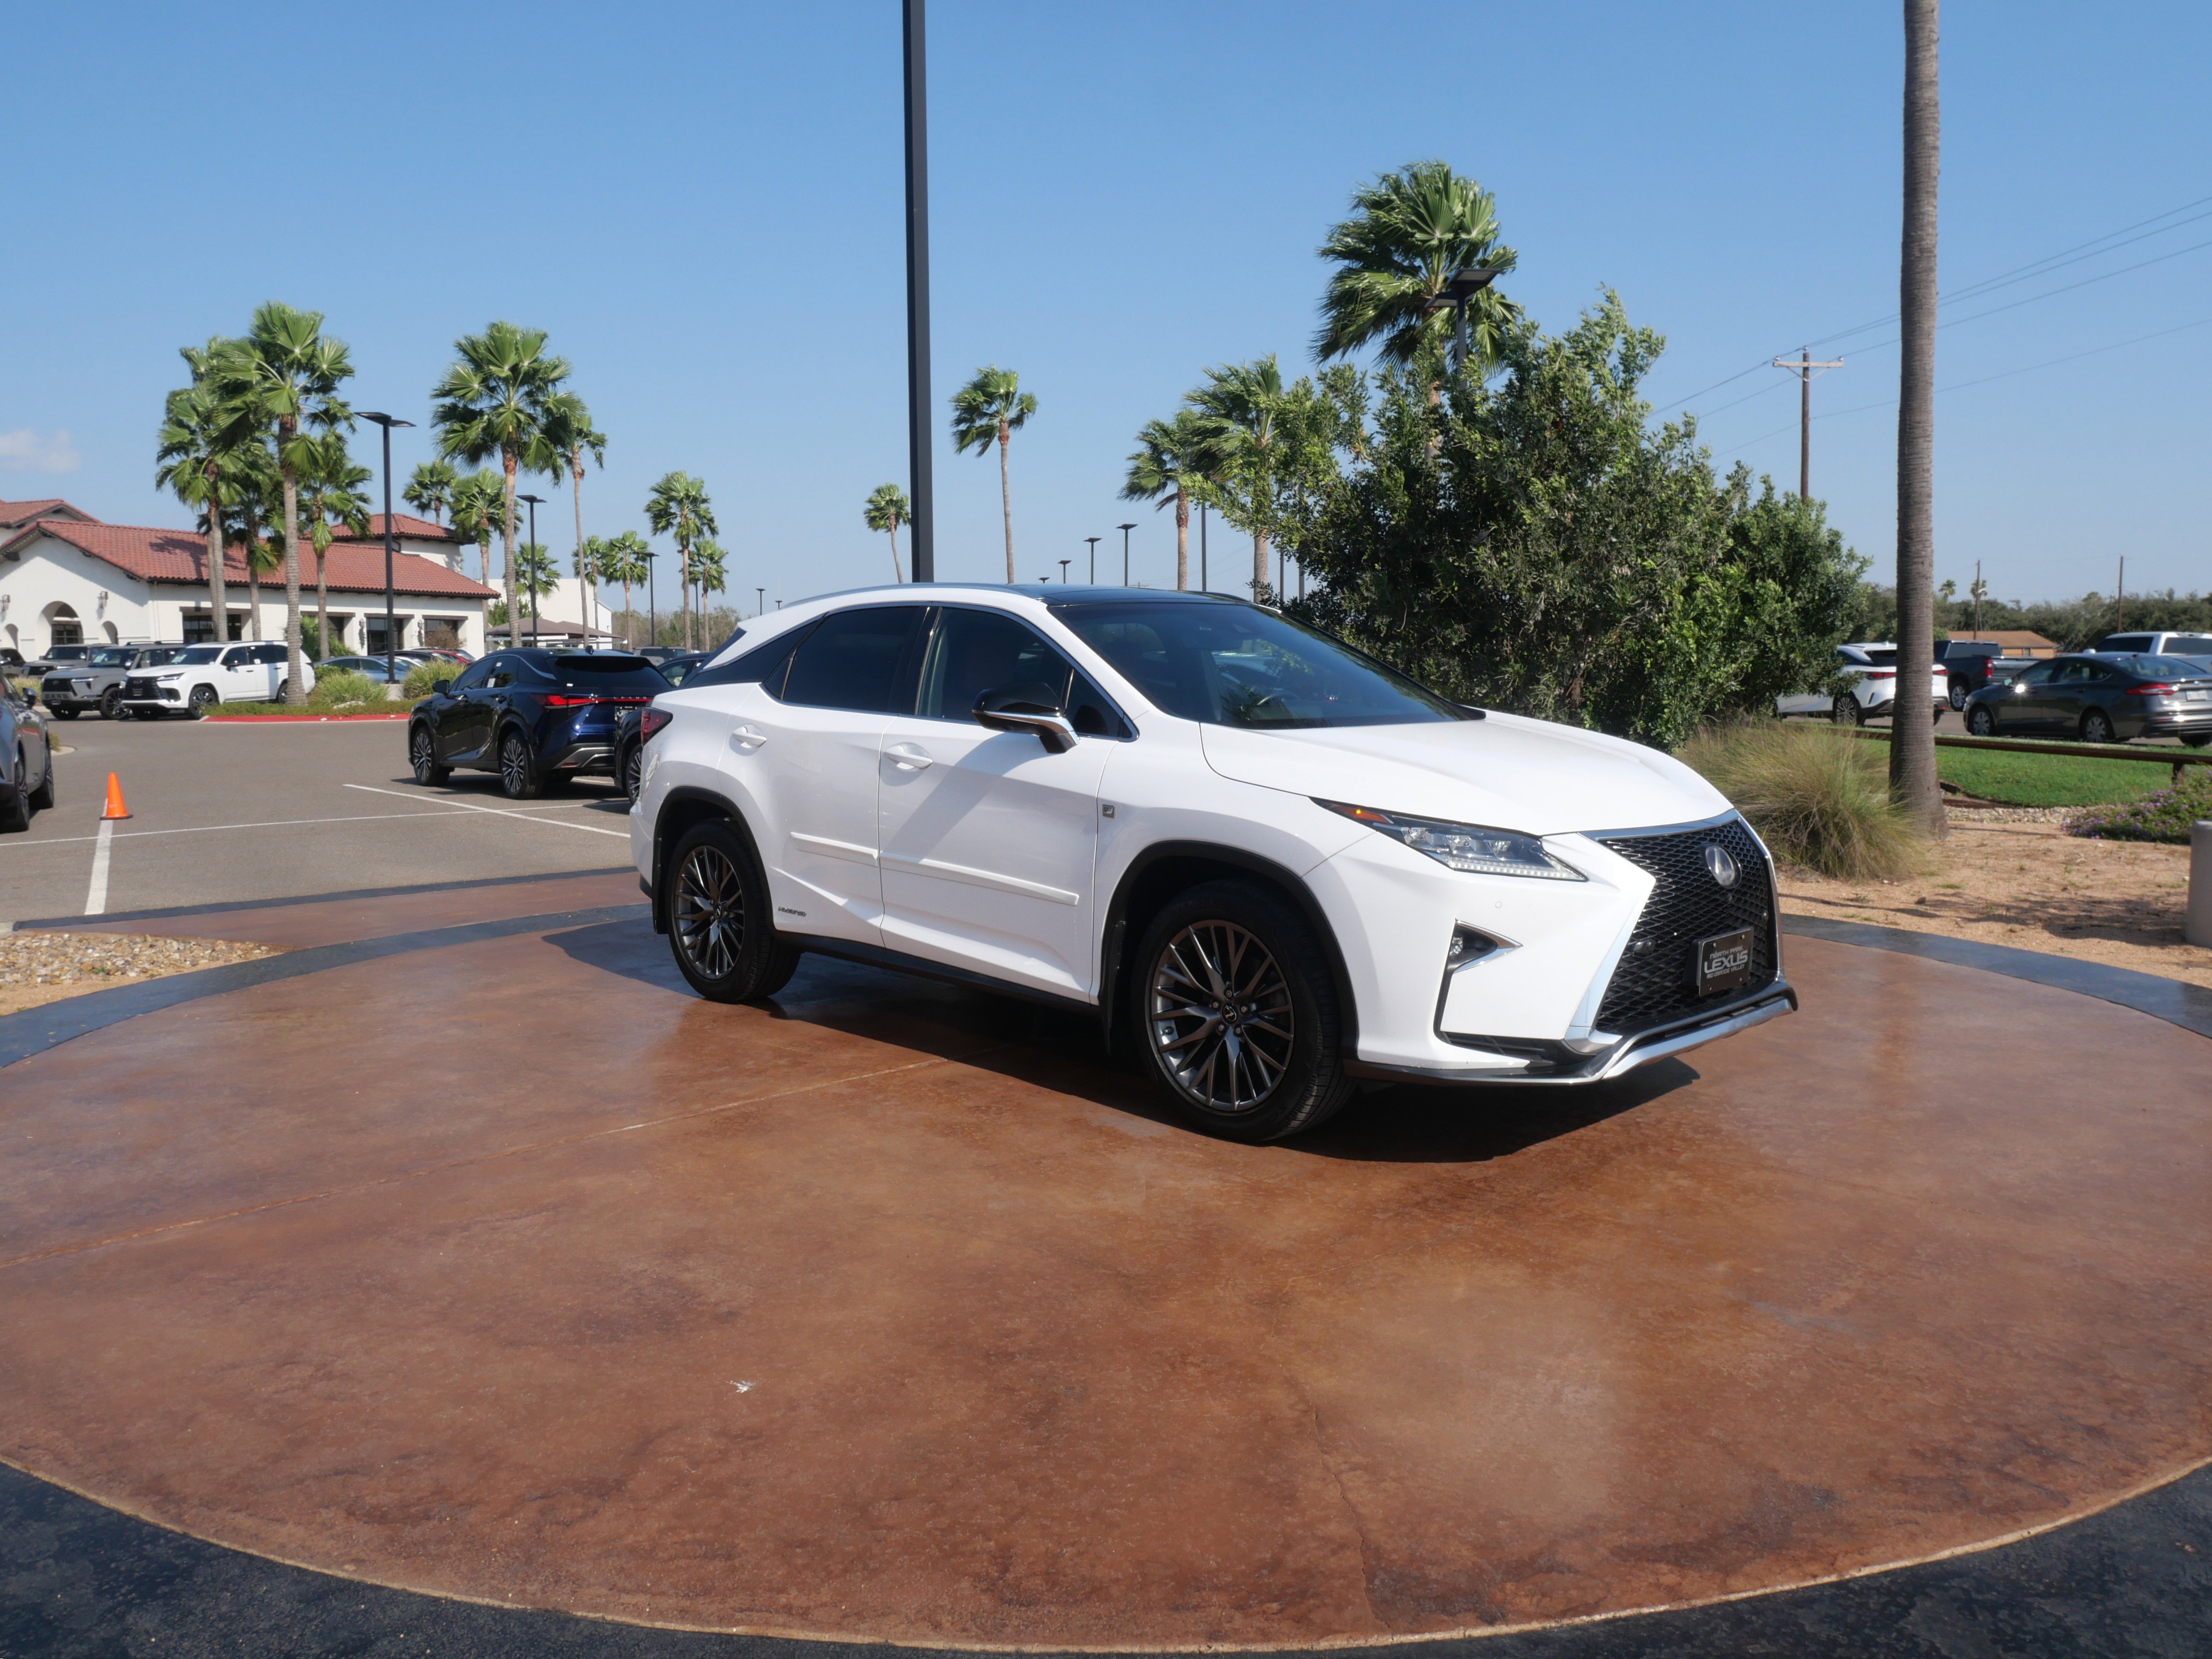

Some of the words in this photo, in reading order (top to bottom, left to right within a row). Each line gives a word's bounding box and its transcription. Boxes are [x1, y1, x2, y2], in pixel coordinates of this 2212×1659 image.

[1730, 945, 1743, 954] PARK
[1704, 950, 1748, 974] LEXUS
[1731, 963, 1745, 972] VALLEY
